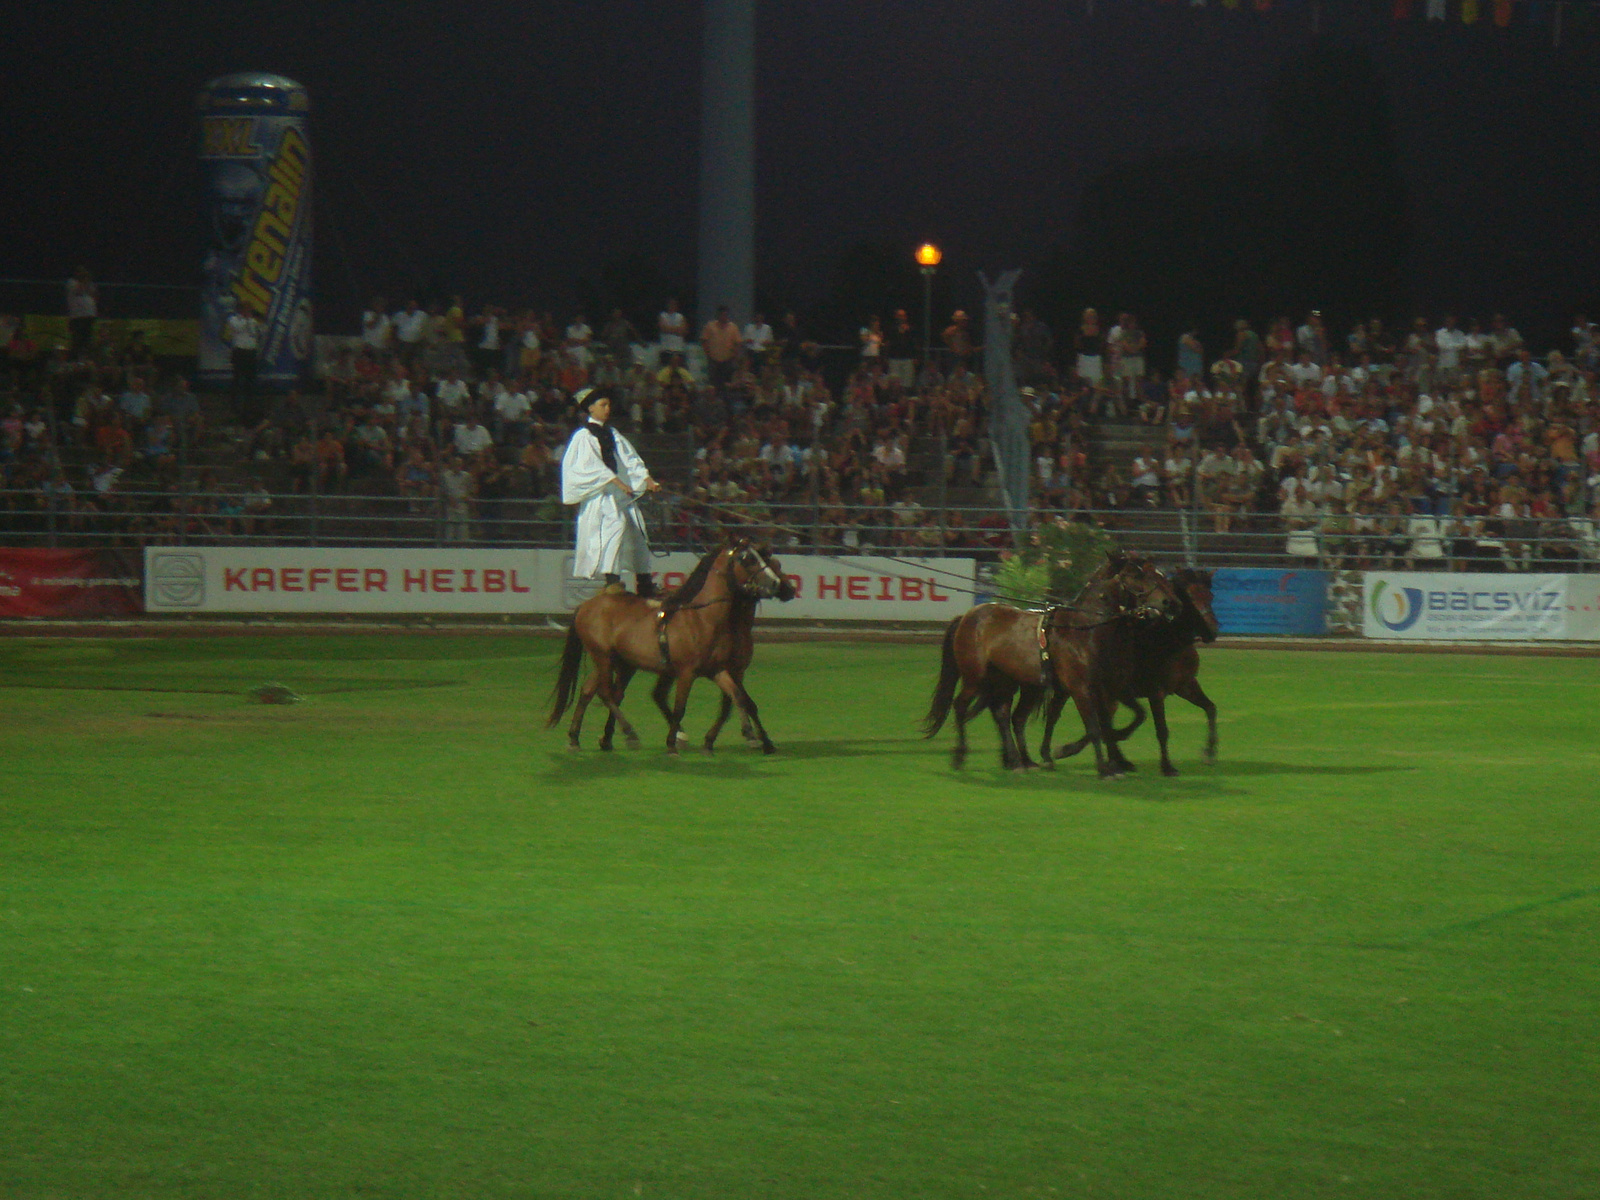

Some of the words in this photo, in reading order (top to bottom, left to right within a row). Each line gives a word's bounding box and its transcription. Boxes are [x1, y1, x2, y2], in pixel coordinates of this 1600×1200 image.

[223, 567, 388, 593] KAEFER
[402, 568, 531, 593] HEIBL
[817, 575, 949, 602] HEIBL
